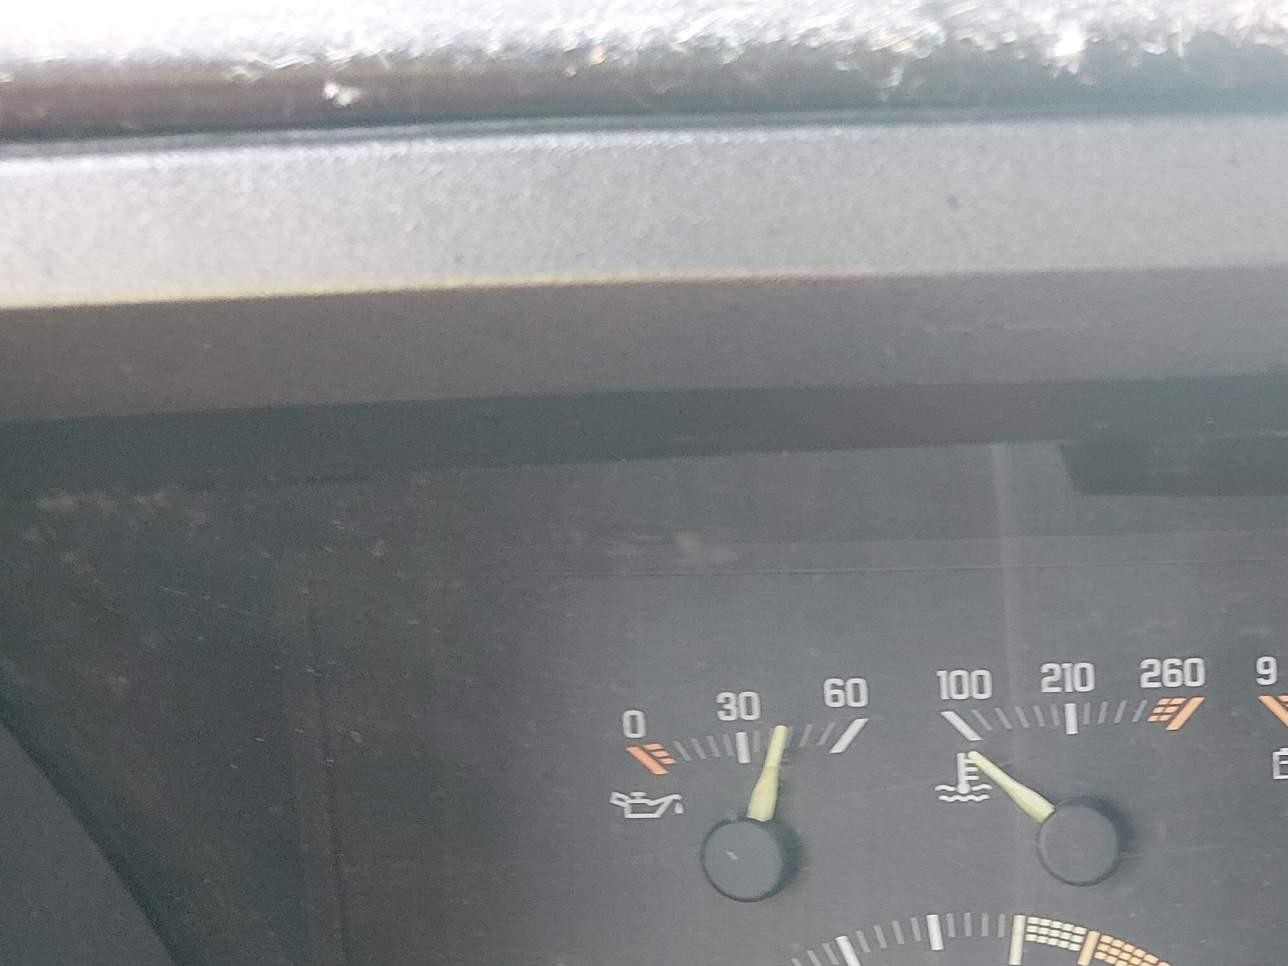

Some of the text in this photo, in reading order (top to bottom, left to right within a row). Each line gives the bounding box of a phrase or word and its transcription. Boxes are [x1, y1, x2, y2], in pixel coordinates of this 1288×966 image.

[936, 669, 993, 699] 100
[1040, 662, 1095, 693] 210
[1139, 657, 1206, 688] 260
[1255, 656, 1278, 685] 9
[716, 691, 761, 720] 30
[823, 678, 868, 707] 60
[622, 711, 646, 738] 0
